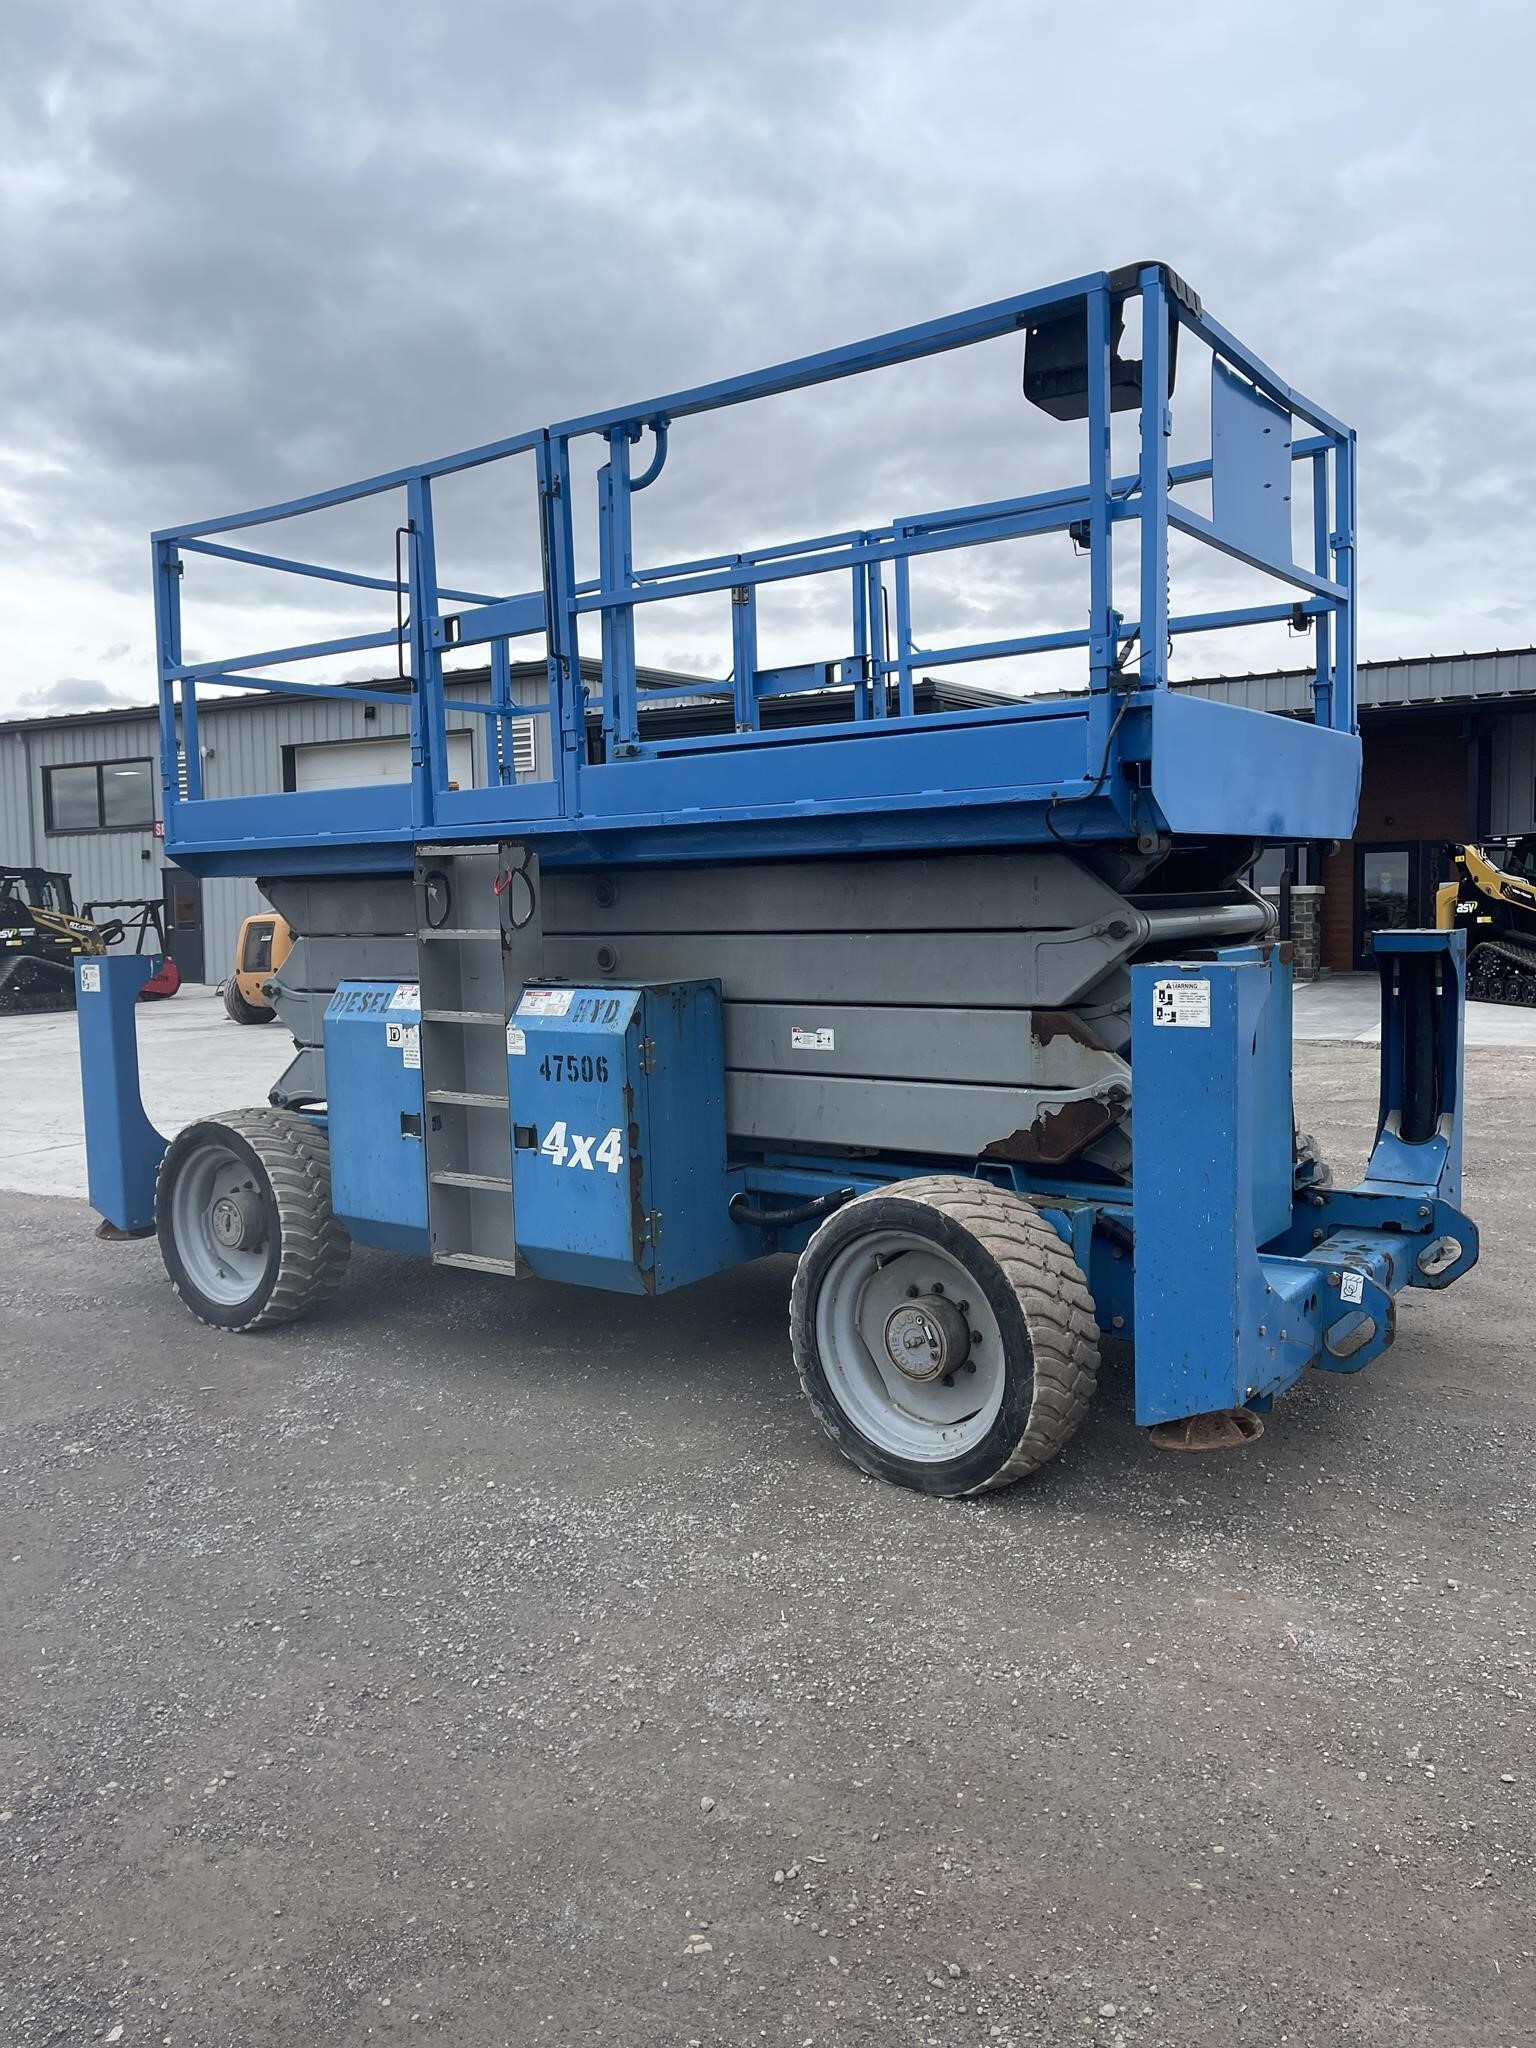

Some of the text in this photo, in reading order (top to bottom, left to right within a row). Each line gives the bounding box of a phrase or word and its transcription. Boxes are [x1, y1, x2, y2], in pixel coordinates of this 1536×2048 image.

[331, 991, 391, 1013] DIESEL
[572, 999, 620, 1024] HYD
[389, 1026, 401, 1041] D
[540, 1055, 608, 1082] 47506
[541, 1121, 624, 1173] 4x4
